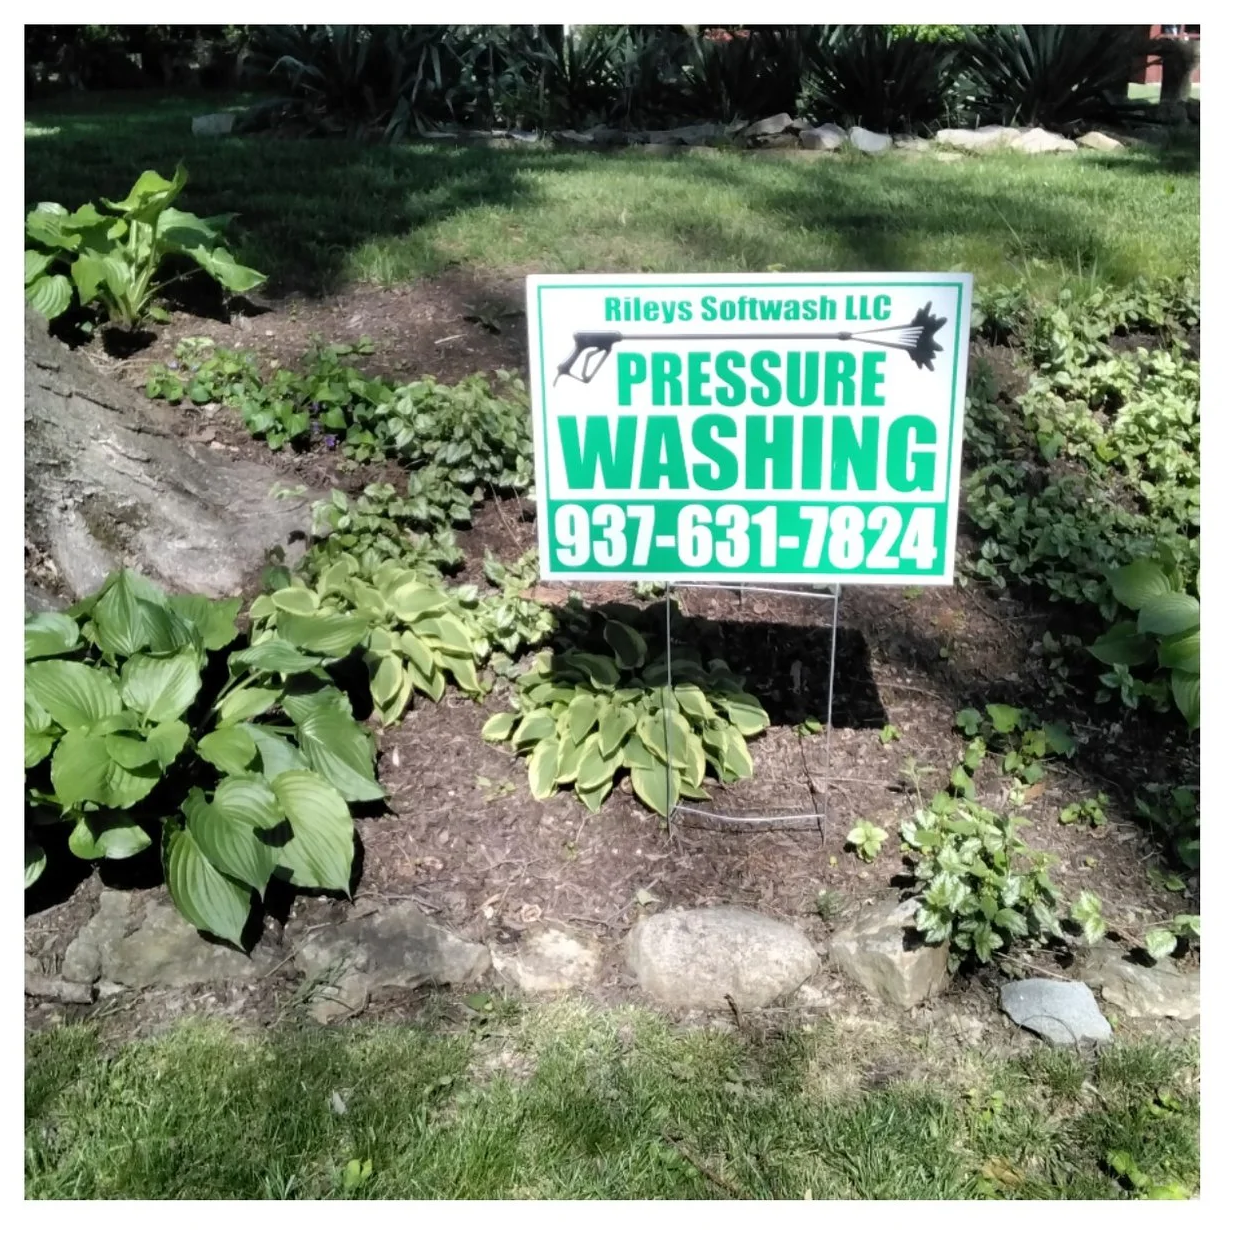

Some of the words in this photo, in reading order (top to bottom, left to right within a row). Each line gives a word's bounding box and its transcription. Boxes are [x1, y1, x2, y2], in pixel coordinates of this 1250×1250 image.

[604, 296, 693, 323] Rileys
[701, 295, 837, 321] Softwash
[845, 294, 892, 320] LLC
[617, 350, 886, 406] PRESSURE
[557, 414, 937, 493] WASHING
[554, 503, 937, 569] 937-631-7824
